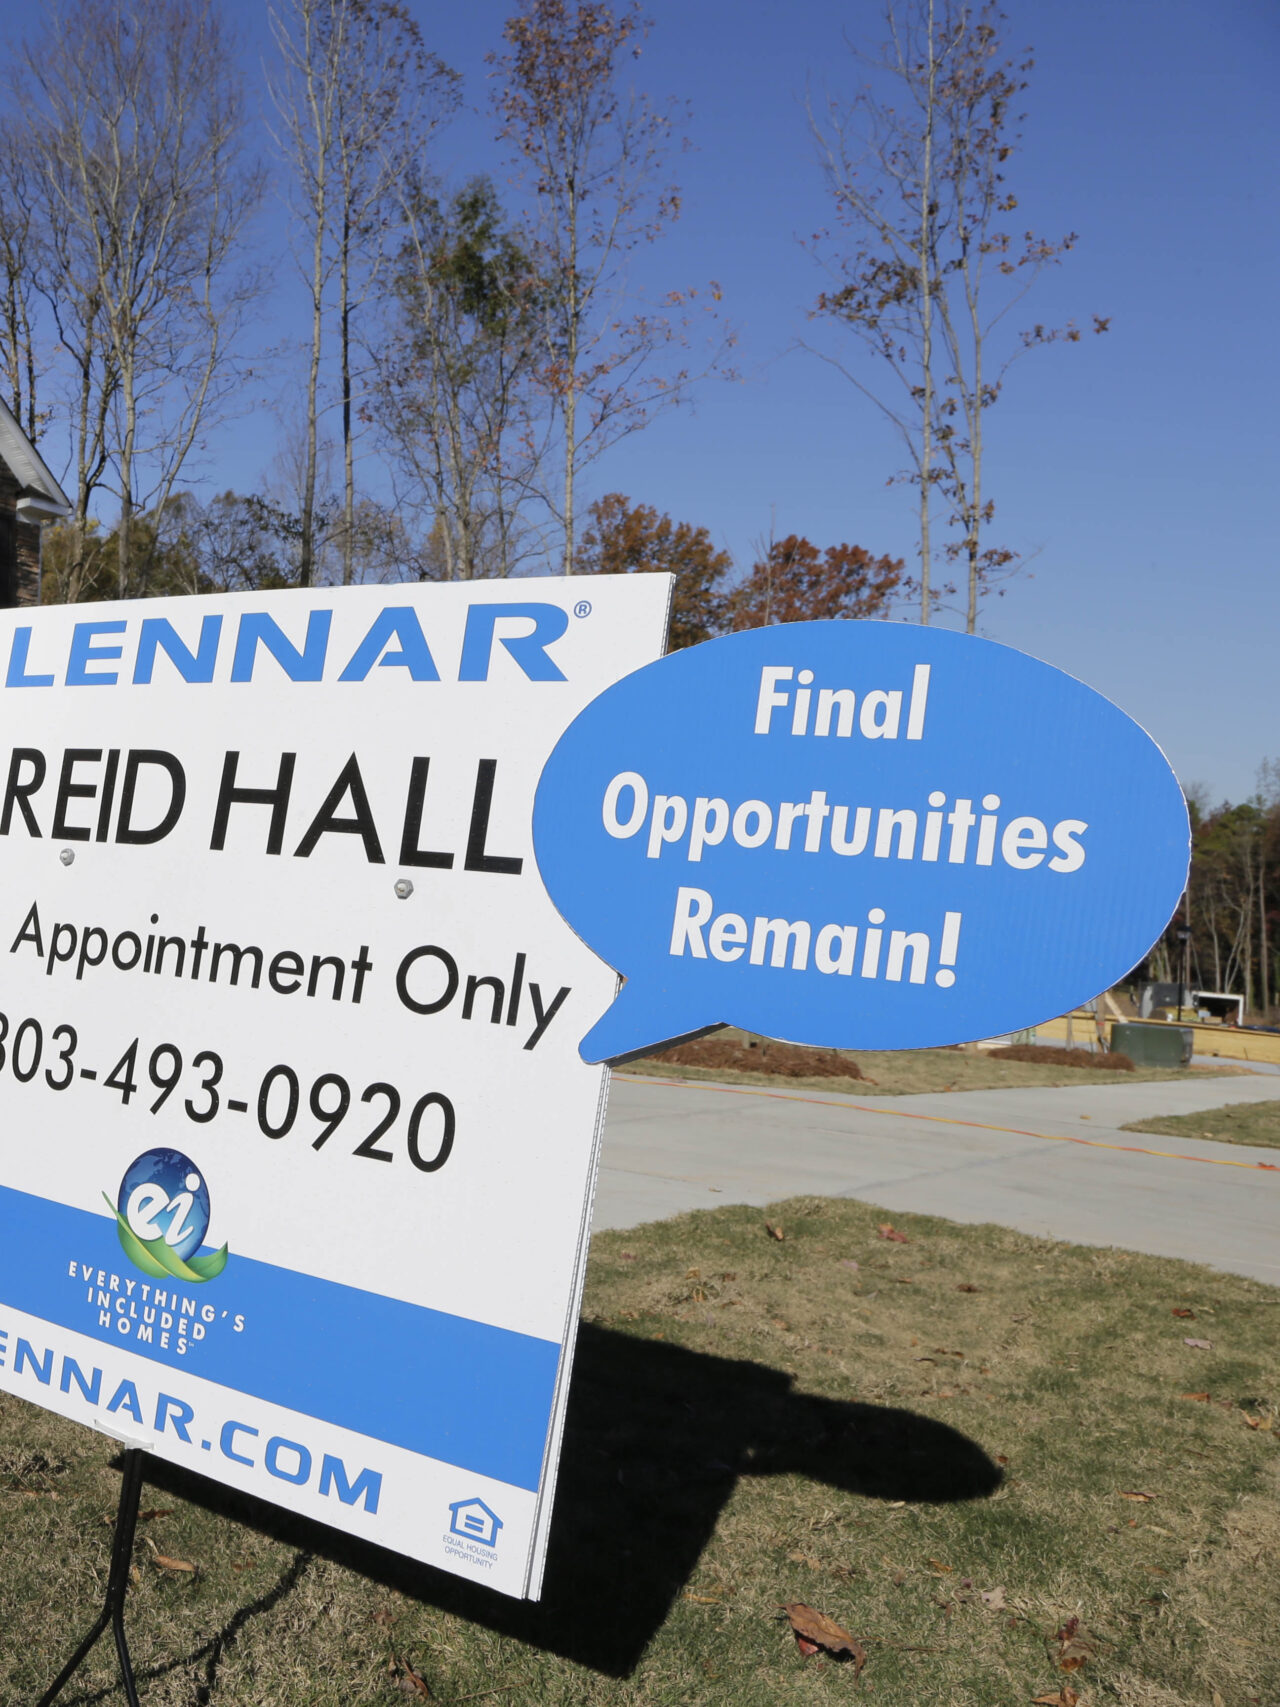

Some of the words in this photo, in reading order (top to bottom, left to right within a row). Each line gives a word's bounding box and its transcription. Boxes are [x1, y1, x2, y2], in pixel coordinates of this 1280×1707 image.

[5, 602, 569, 687] LENNAR
[753, 663, 932, 741] Final
[0, 748, 187, 845] REID
[210, 750, 524, 876] HALL
[602, 770, 1089, 874] Opportunities
[10, 901, 373, 1004] Appointment
[396, 944, 572, 1051] Only
[669, 886, 963, 989] Remain!
[68, 1260, 246, 1333] EVERYTHING'S
[87, 1286, 206, 1341] INCLUDED
[98, 1310, 188, 1355] HOMES
[442, 1534, 464, 1549] EQUAL
[466, 1543, 498, 1561] HOUSING
[444, 1545, 493, 1569] OPPORTUNITY
